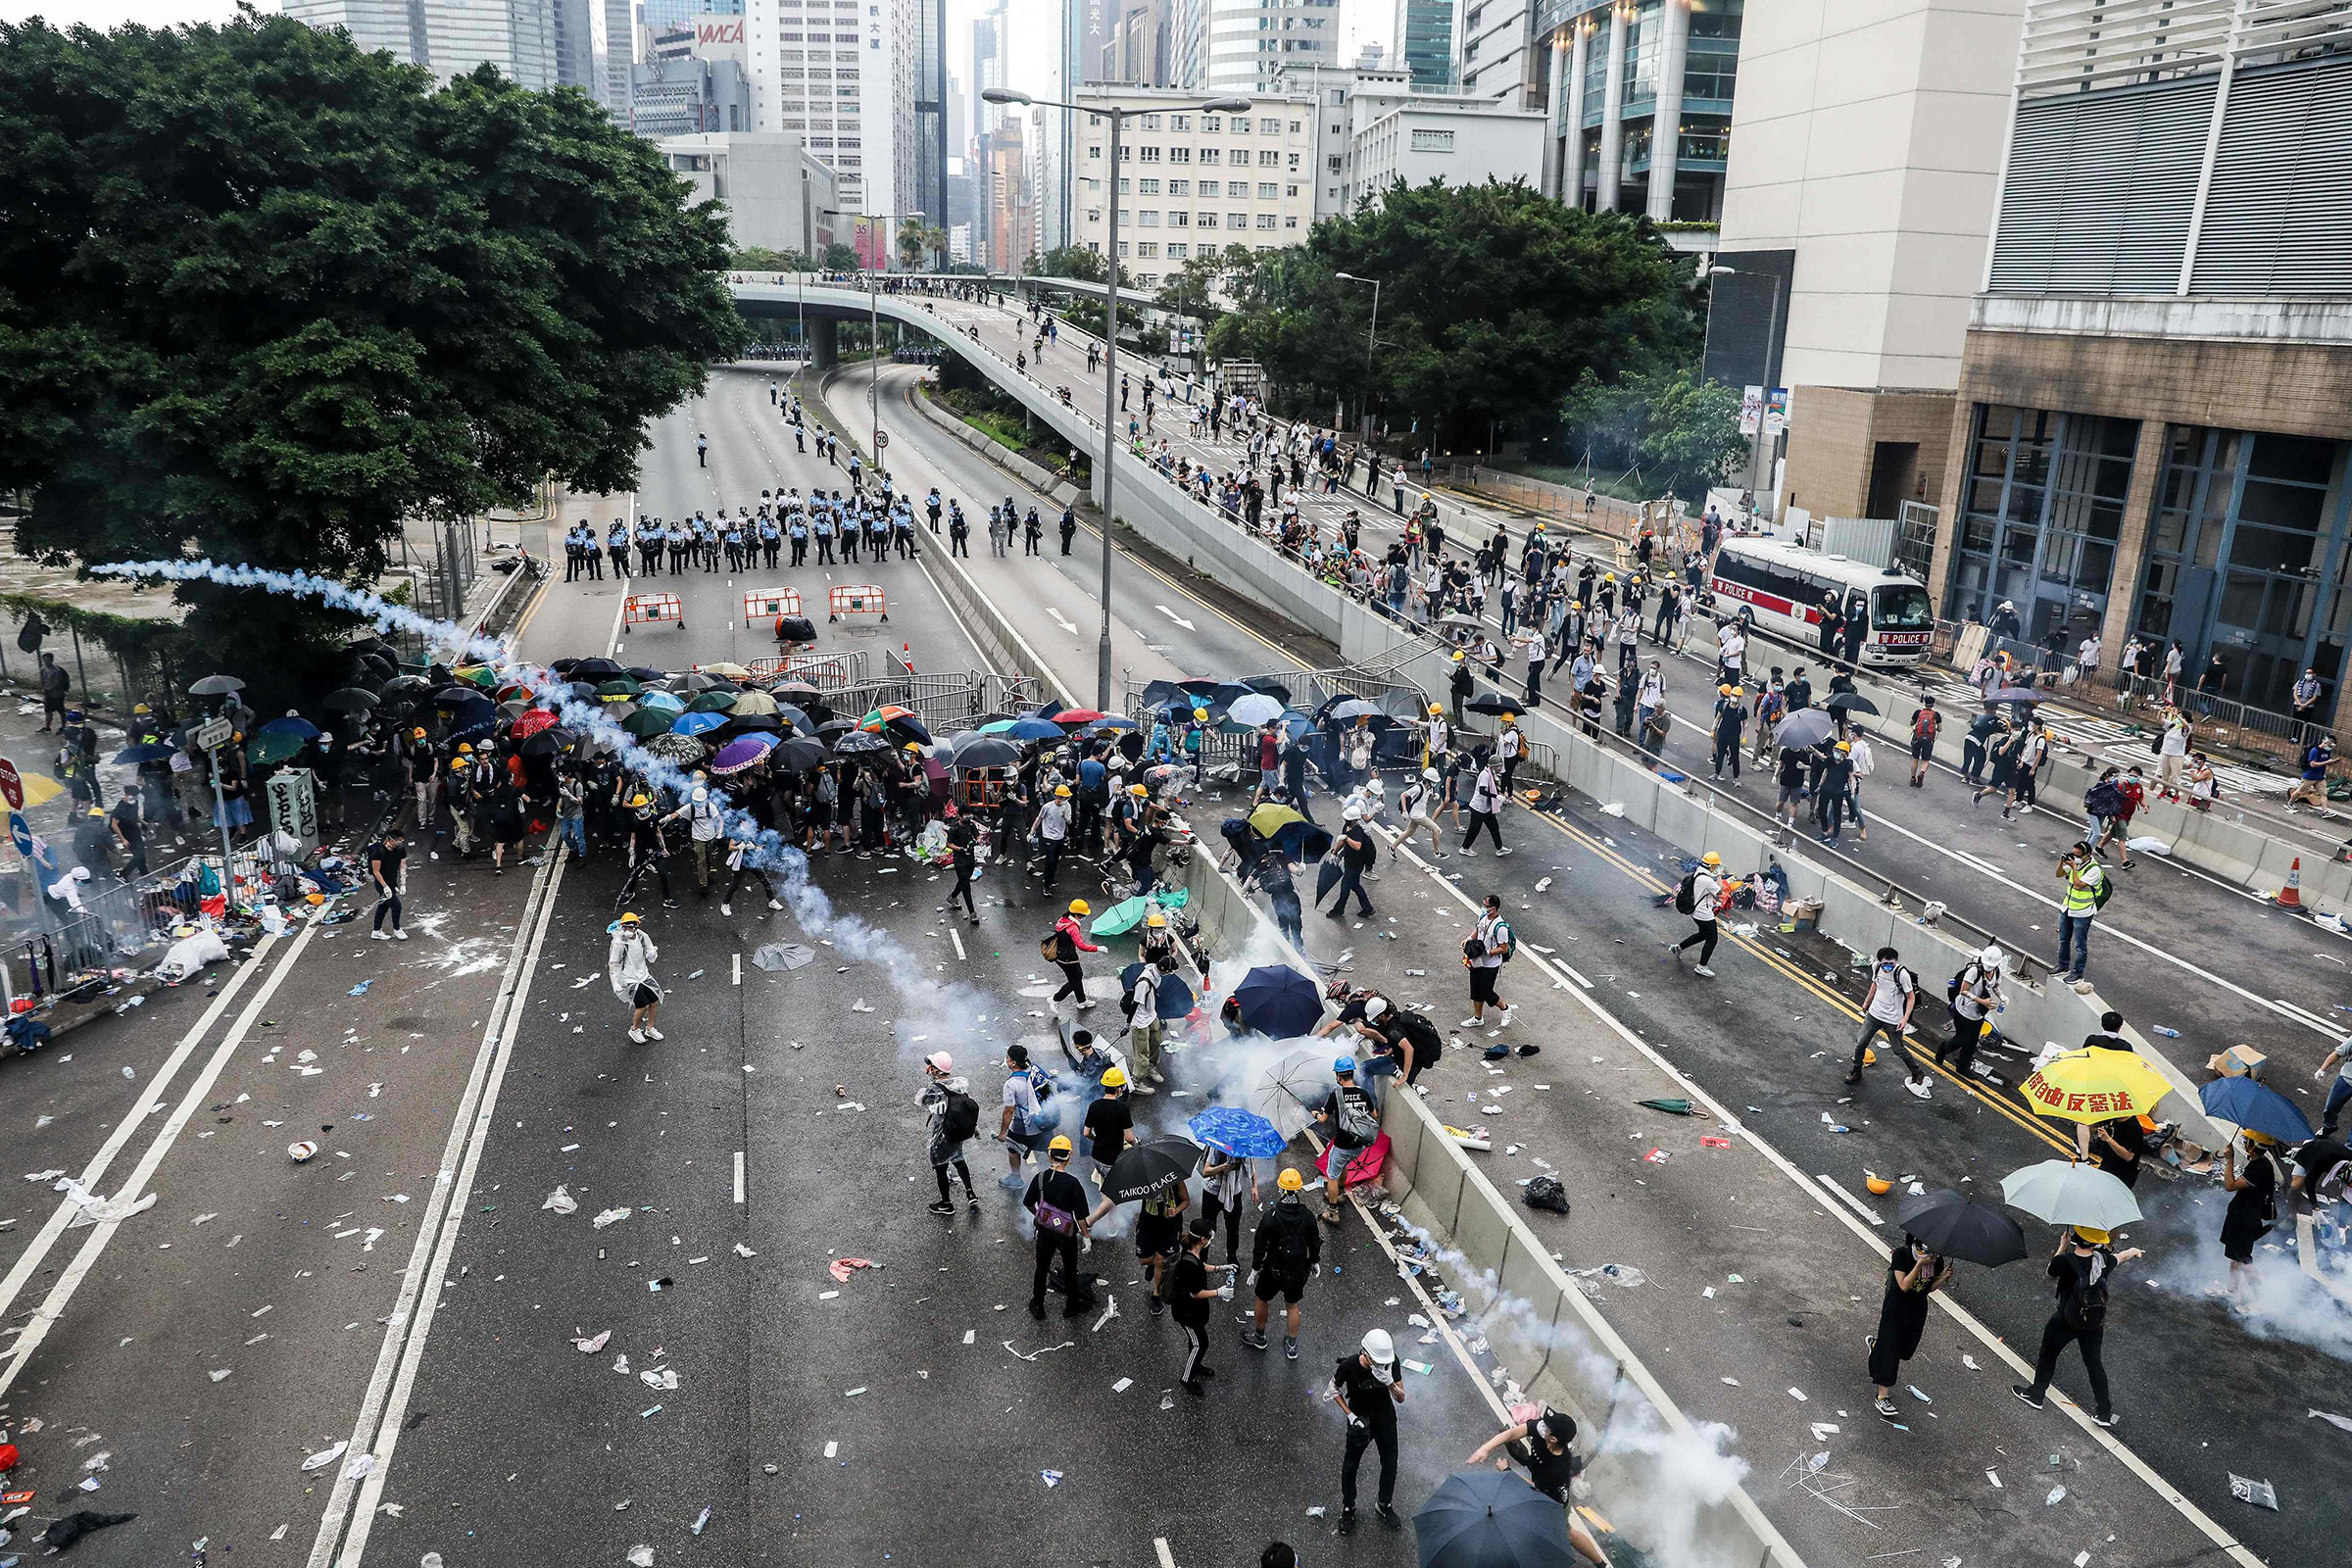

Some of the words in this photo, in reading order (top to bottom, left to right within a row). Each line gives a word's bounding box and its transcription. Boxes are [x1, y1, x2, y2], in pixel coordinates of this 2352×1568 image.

[698, 19, 744, 48] YMCA
[876, 435, 887, 444] 70
[1725, 583, 1746, 600] POLICE
[1891, 634, 1921, 644] POLICE
[0, 768, 18, 784] STOP
[1118, 1185, 1151, 1199] TAIKOO
[1151, 1171, 1178, 1192] PLACE
